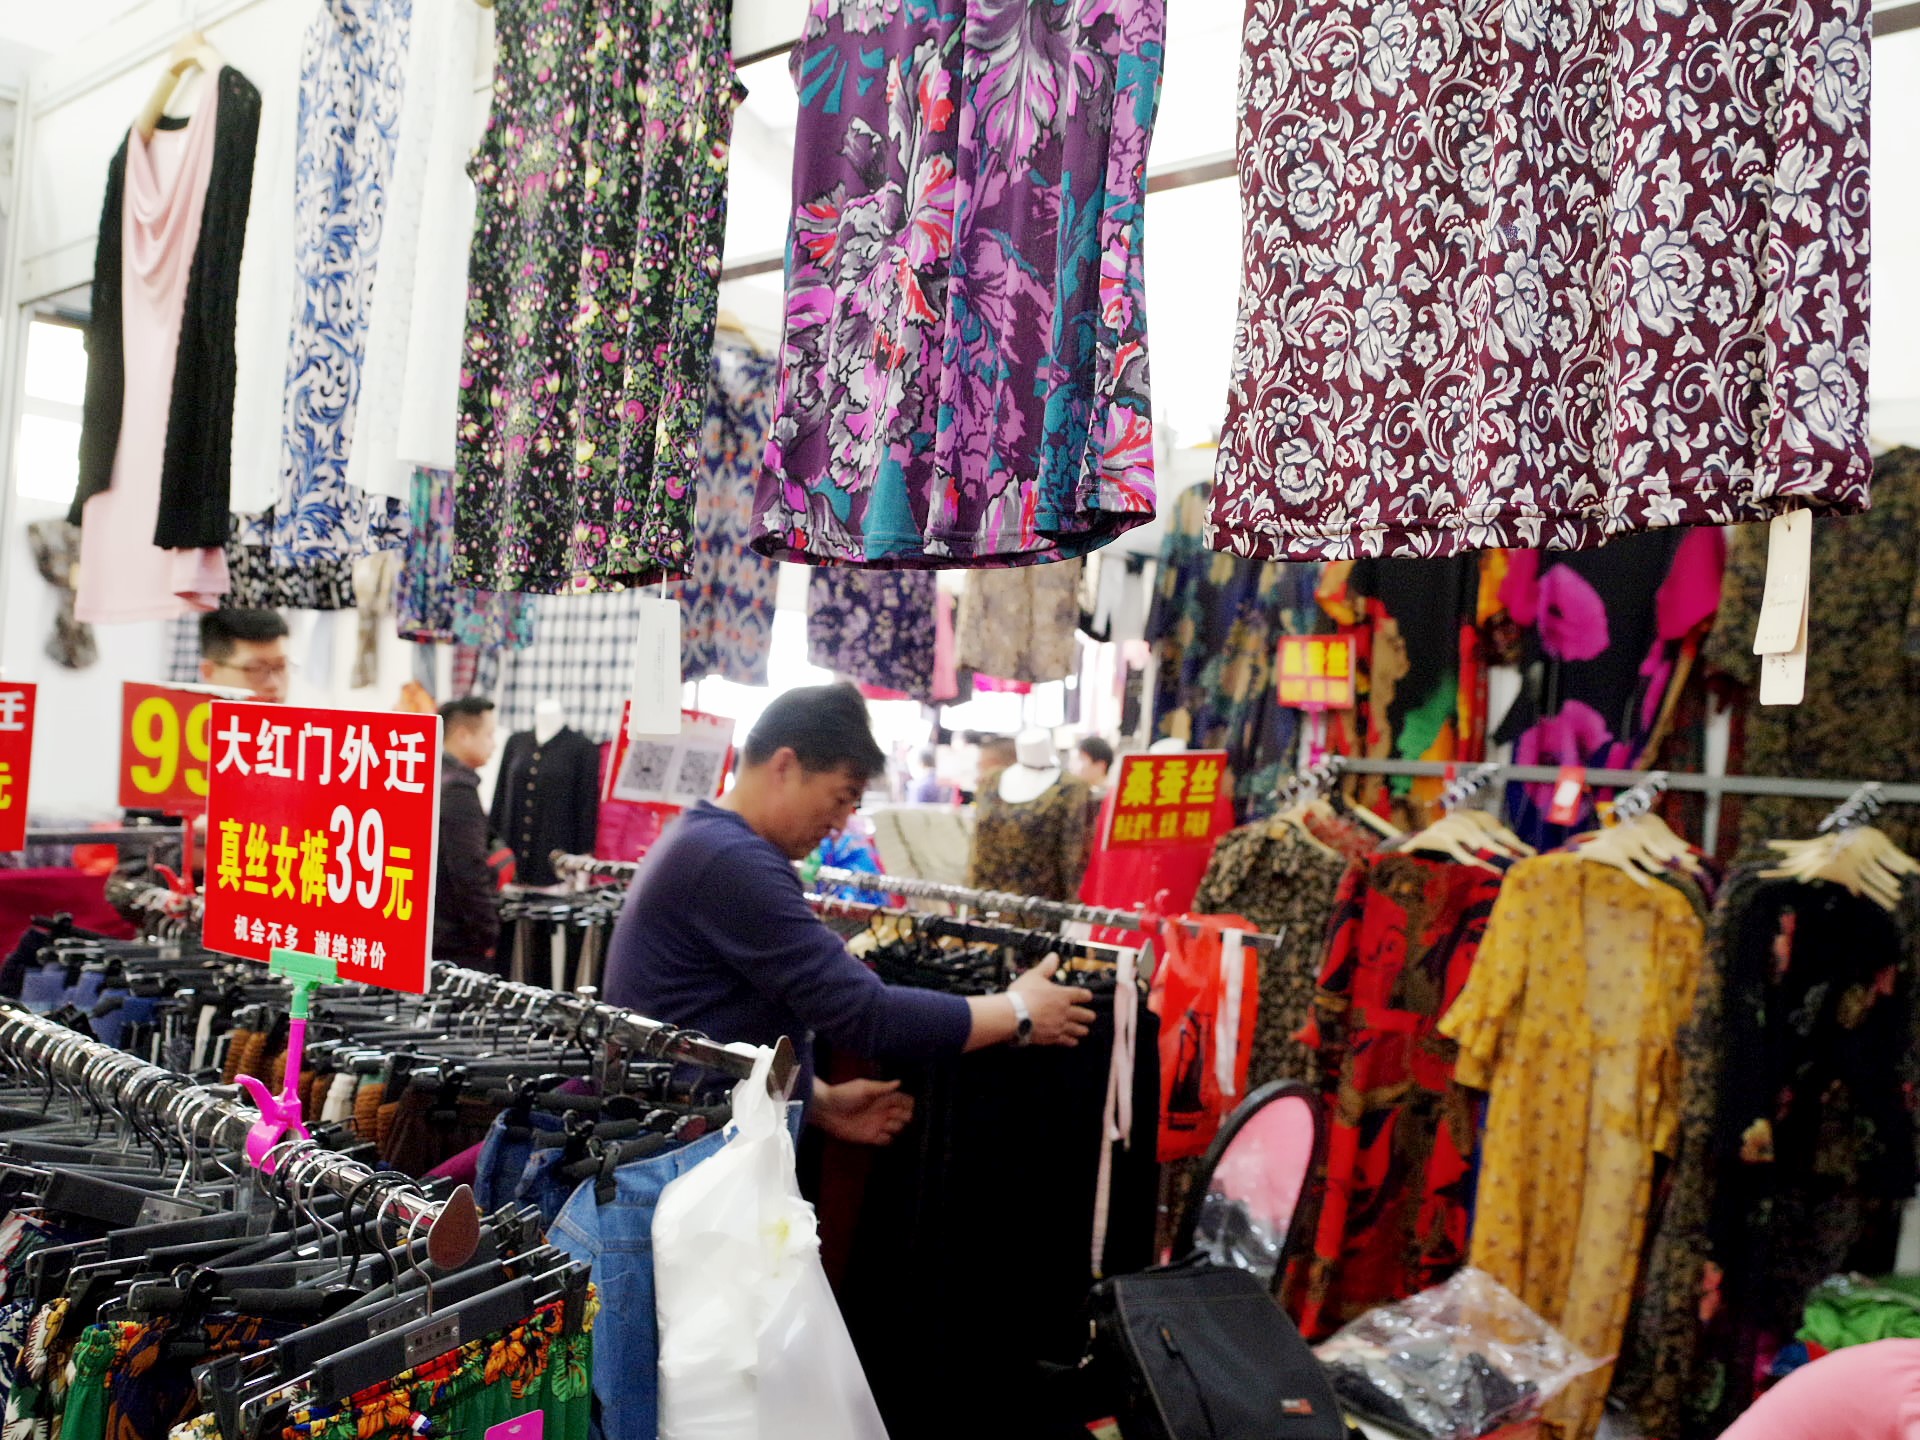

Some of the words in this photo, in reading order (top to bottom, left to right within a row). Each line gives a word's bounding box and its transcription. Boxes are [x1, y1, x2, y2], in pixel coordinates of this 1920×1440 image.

[215, 714, 426, 794] 大红门外迁
[1120, 759, 1219, 808] 桑蚕丝
[234, 914, 299, 951] 机会不多
[313, 929, 387, 971] 谢绝讲价
